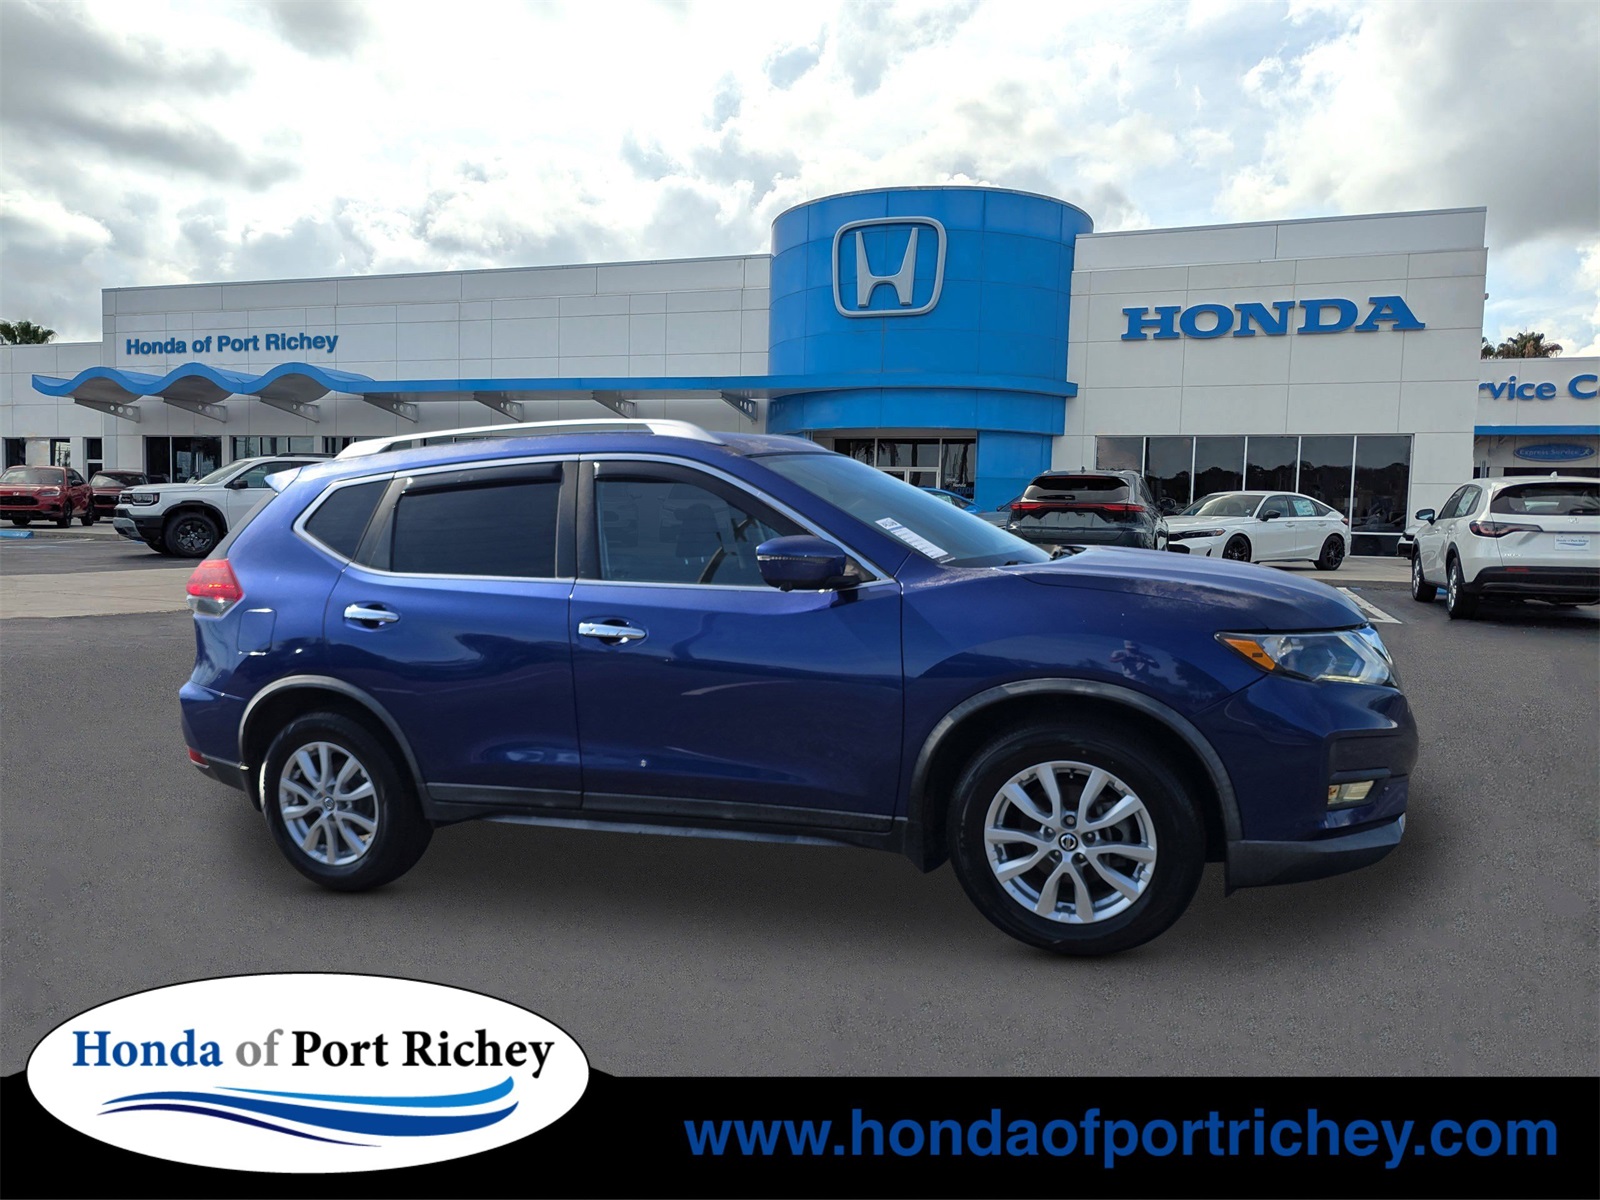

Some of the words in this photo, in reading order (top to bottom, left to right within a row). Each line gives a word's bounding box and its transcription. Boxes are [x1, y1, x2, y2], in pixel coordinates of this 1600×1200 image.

[1121, 295, 1426, 341] HONDA
[126, 337, 187, 355] Honda
[191, 335, 212, 353] of
[217, 335, 260, 352] Port
[265, 332, 339, 354] Richey
[1567, 373, 1600, 400] C
[1519, 448, 1549, 456] Express
[1551, 448, 1579, 456] Service
